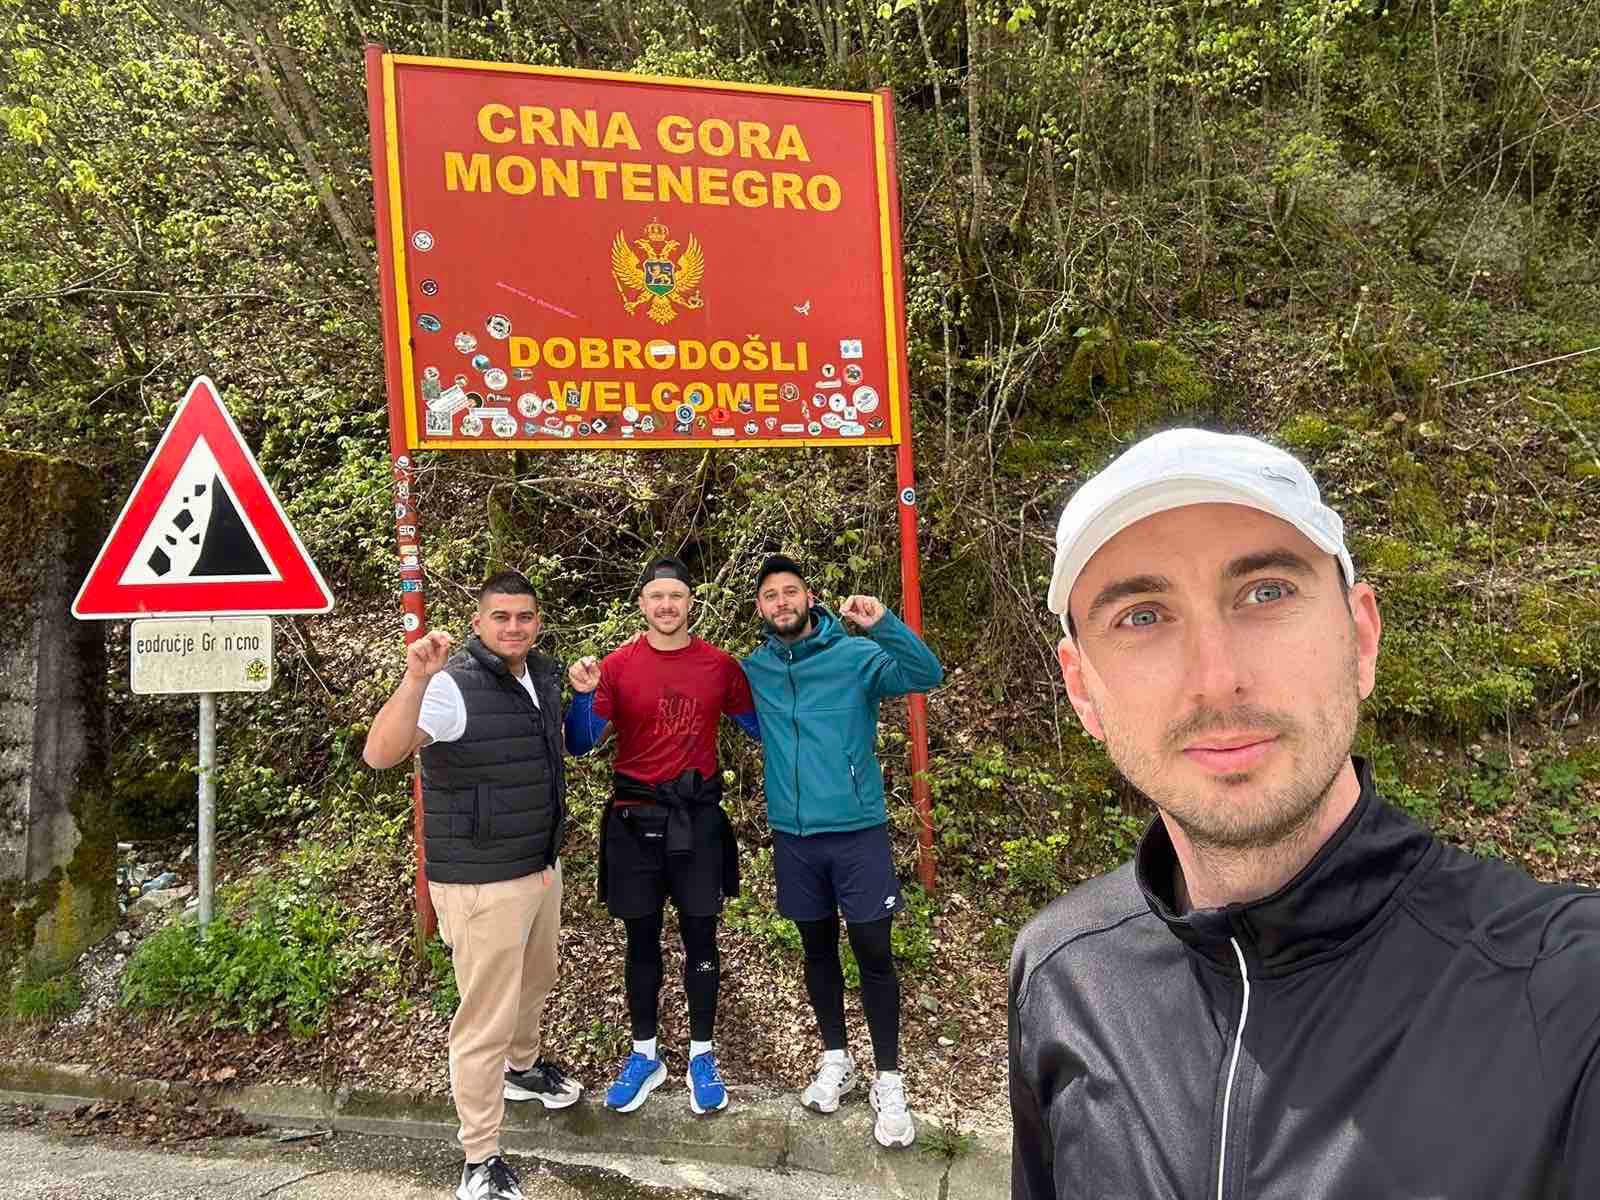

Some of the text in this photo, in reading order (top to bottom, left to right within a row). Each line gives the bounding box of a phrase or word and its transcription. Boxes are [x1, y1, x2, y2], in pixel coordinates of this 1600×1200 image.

[477, 103, 809, 163] CRNA GORA
[444, 151, 842, 212] MONTENEGRO
[508, 333, 809, 372] DOBRODOŠLI
[547, 380, 780, 413] WELCOME
[658, 697, 698, 719] RUN
